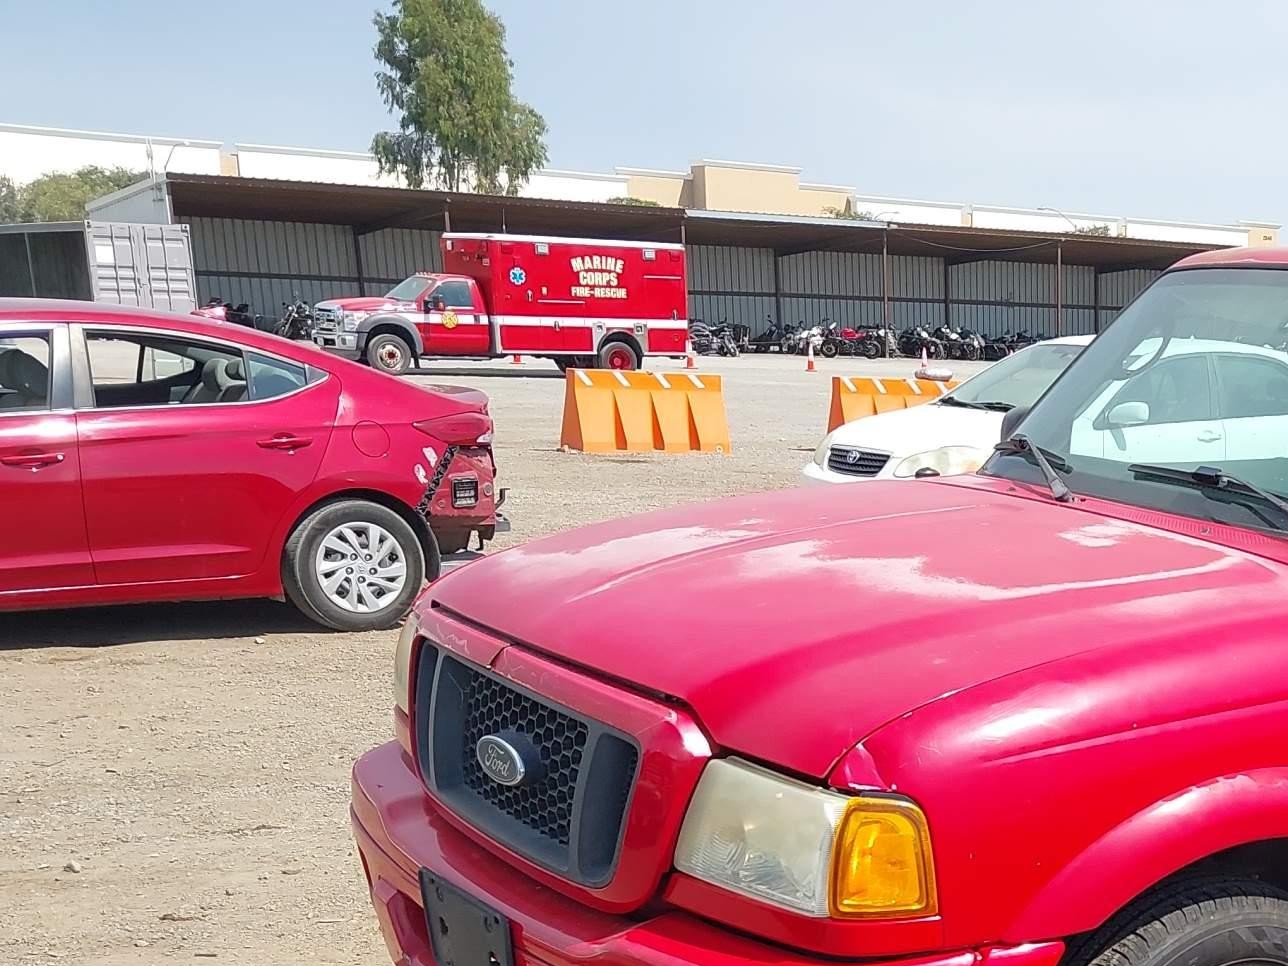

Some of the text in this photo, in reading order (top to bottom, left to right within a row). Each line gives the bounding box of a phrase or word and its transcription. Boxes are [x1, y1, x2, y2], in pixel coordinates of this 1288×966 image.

[570, 255, 625, 274] MARINE
[579, 271, 618, 286] CORPS
[571, 286, 628, 298] FIRE-RESCUE
[484, 743, 511, 777] Ford
